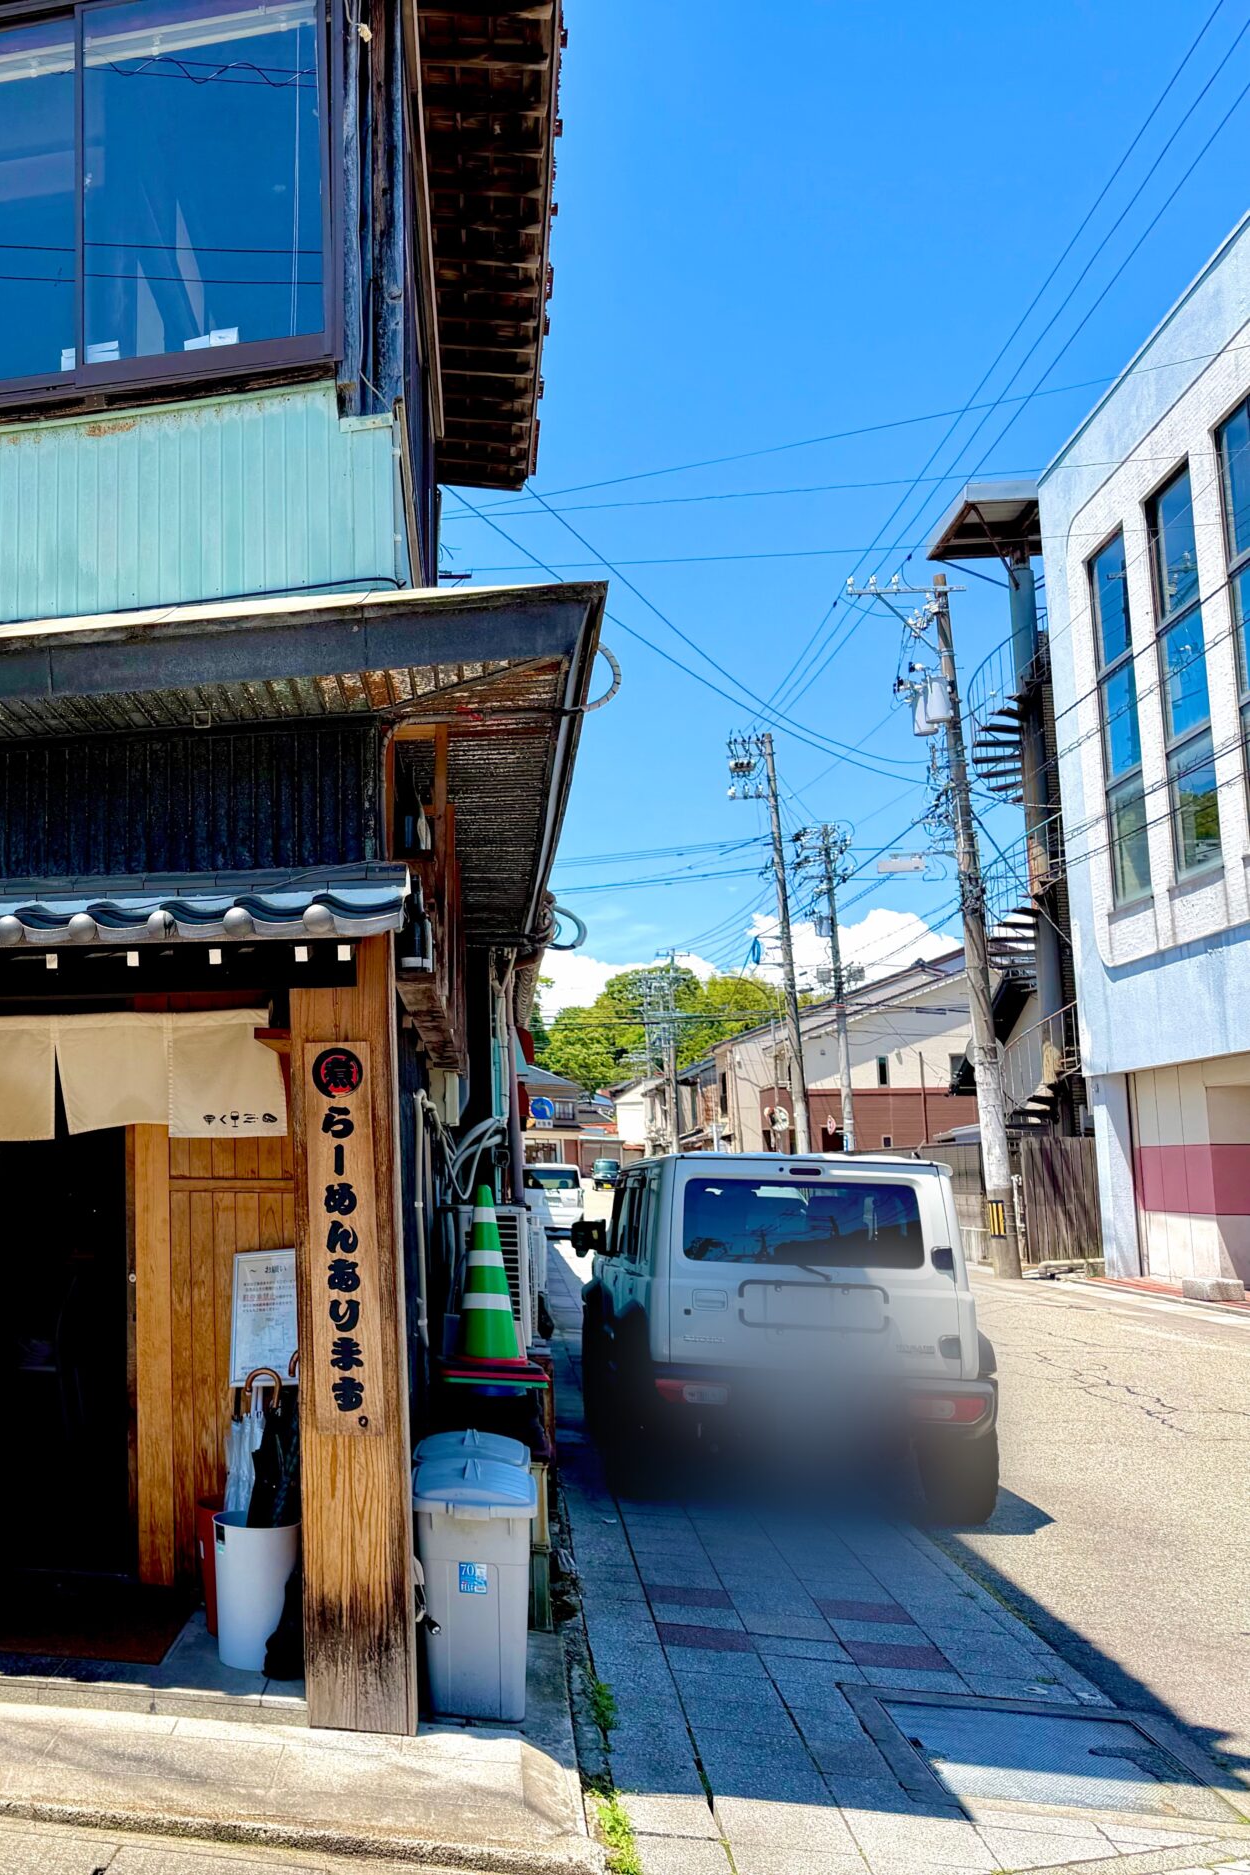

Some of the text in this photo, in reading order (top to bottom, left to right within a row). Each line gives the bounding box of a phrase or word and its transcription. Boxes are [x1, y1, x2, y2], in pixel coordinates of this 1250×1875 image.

[321, 1105, 369, 1428] らーめんあります。
[460, 1564, 475, 1576] 70
